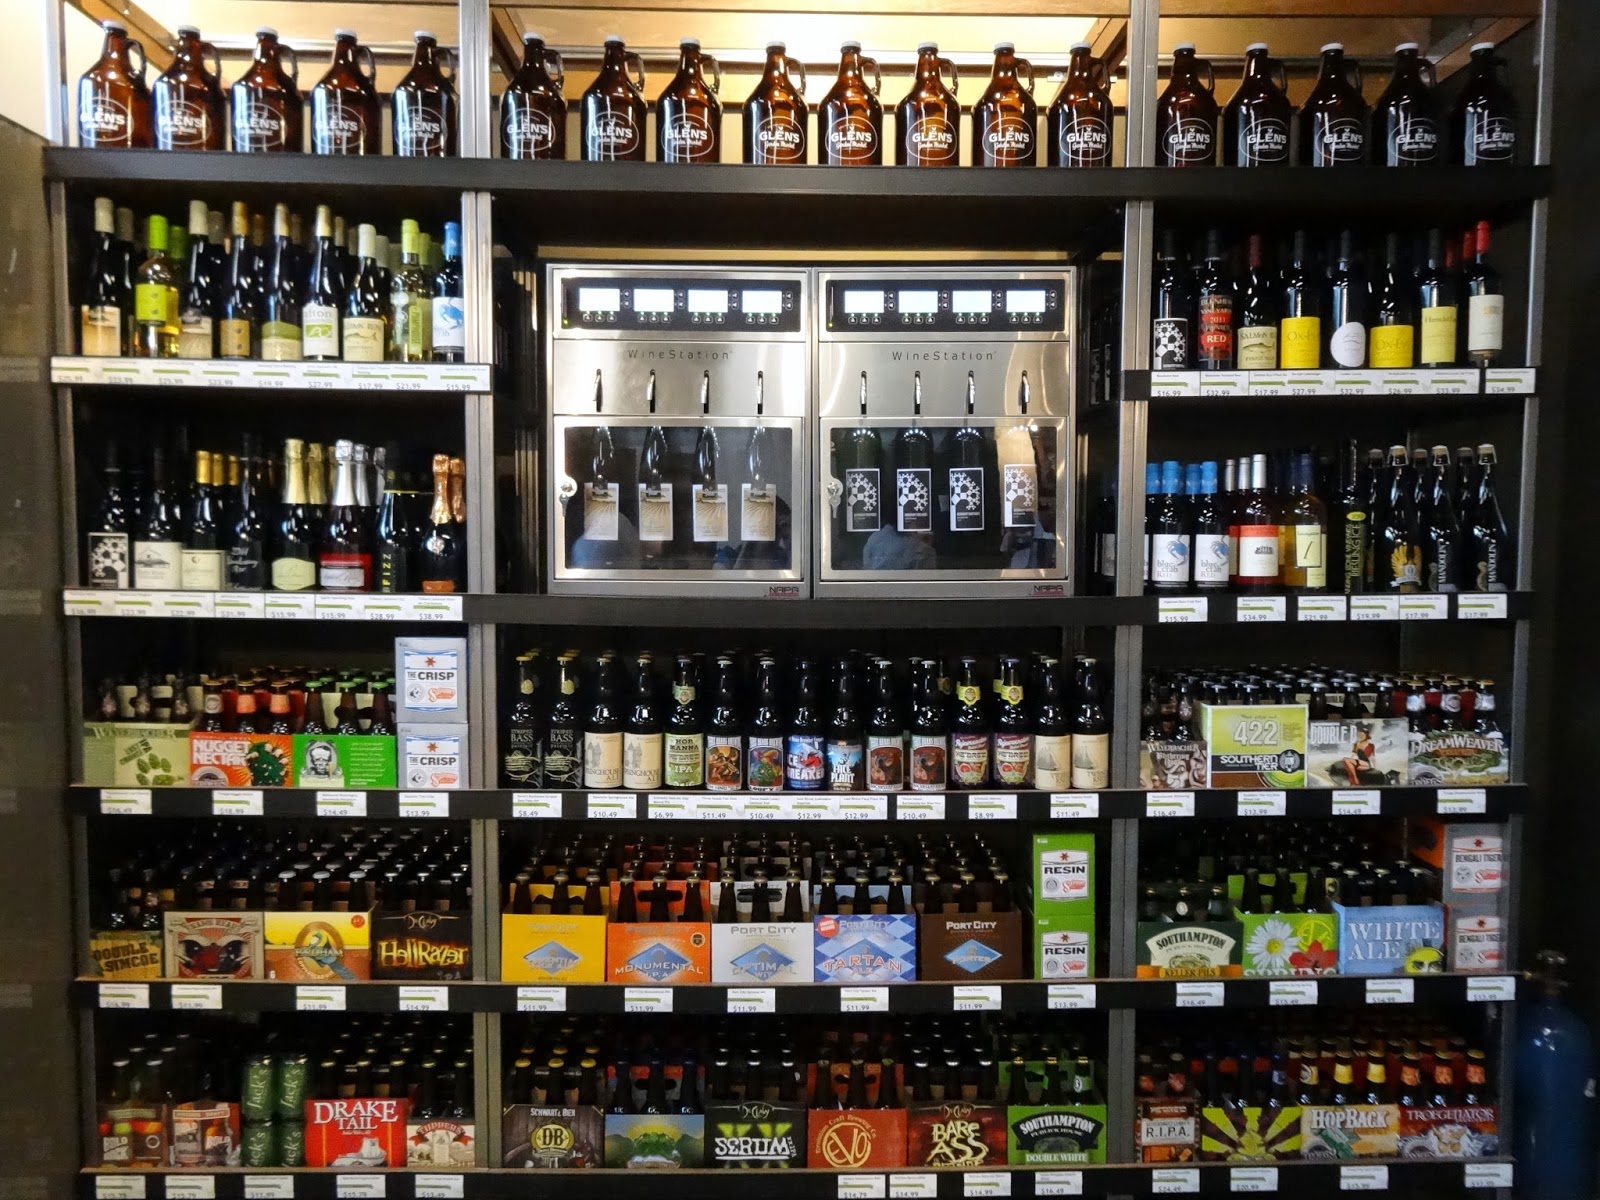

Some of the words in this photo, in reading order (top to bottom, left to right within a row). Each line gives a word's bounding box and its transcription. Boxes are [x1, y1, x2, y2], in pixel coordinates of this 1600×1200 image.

[507, 125, 548, 134] GLEN'S
[591, 128, 632, 138] GLEN'S
[667, 130, 708, 140] GLEN'S
[759, 131, 800, 143] GLEN'S
[831, 132, 872, 142] GLEN'S
[912, 132, 952, 143] GLEN'S
[989, 132, 1029, 142] GLEN'S
[1067, 132, 1107, 143] GLEN'S
[1169, 133, 1210, 143] GLEN'S
[1247, 133, 1286, 143] GLEN'S
[1324, 133, 1363, 143] GLEN'S
[1396, 133, 1437, 143] GLEN'S
[1474, 132, 1515, 143] GLEN'S
[1207, 335, 1227, 343] RED
[628, 350, 729, 360] WineStation
[892, 351, 993, 361] WineStation
[1162, 564, 1178, 572] crab
[1206, 564, 1222, 572] crab
[1438, 545, 1447, 583] MANDOLIN
[1488, 544, 1496, 582] MANDOLIN
[418, 672, 454, 680] CRISP
[511, 734, 534, 742] BASS
[550, 734, 573, 742] BASS
[1234, 720, 1278, 746] 422
[1310, 726, 1347, 744] DOUBLE
[1349, 726, 1357, 744] D
[193, 739, 249, 753] NUGGET
[420, 757, 456, 765] CRISP
[1220, 755, 1278, 764] SOUTHERN
[674, 765, 693, 773] IPA
[833, 765, 850, 773] FACE
[831, 772, 855, 783] PLANT
[1455, 854, 1482, 863] BENGALI
[1044, 866, 1085, 874] RESIN
[1348, 922, 1440, 940] WHITE
[1156, 932, 1226, 950] SOUTHAMPTON
[1459, 934, 1483, 943] BENGALI
[94, 941, 148, 961] DOUBLE
[379, 939, 468, 966] HellRazer
[1045, 947, 1085, 955] RESIN
[1348, 942, 1400, 960] ALE
[104, 954, 159, 972] SIMCOE
[824, 955, 901, 973] TARTAN
[615, 962, 703, 975] MONUMENTAL
[732, 962, 796, 976] OPTIMAL
[247, 1068, 268, 1109] Jack's
[281, 1068, 301, 1108] Jack's
[314, 1101, 398, 1124] DRAKE
[562, 1109, 575, 1117] BIER
[336, 1117, 378, 1130] TAIL
[1020, 1115, 1095, 1134] SOUTHAMPTON
[542, 1128, 563, 1146] DB
[1146, 1127, 1190, 1137] R.I.P.A.
[715, 1138, 790, 1155] SERUM
[828, 1129, 868, 1164] EVO
[927, 1137, 989, 1163] ASS
[1026, 1153, 1059, 1163] DOUBLE
[1060, 1153, 1087, 1162] WHITE
